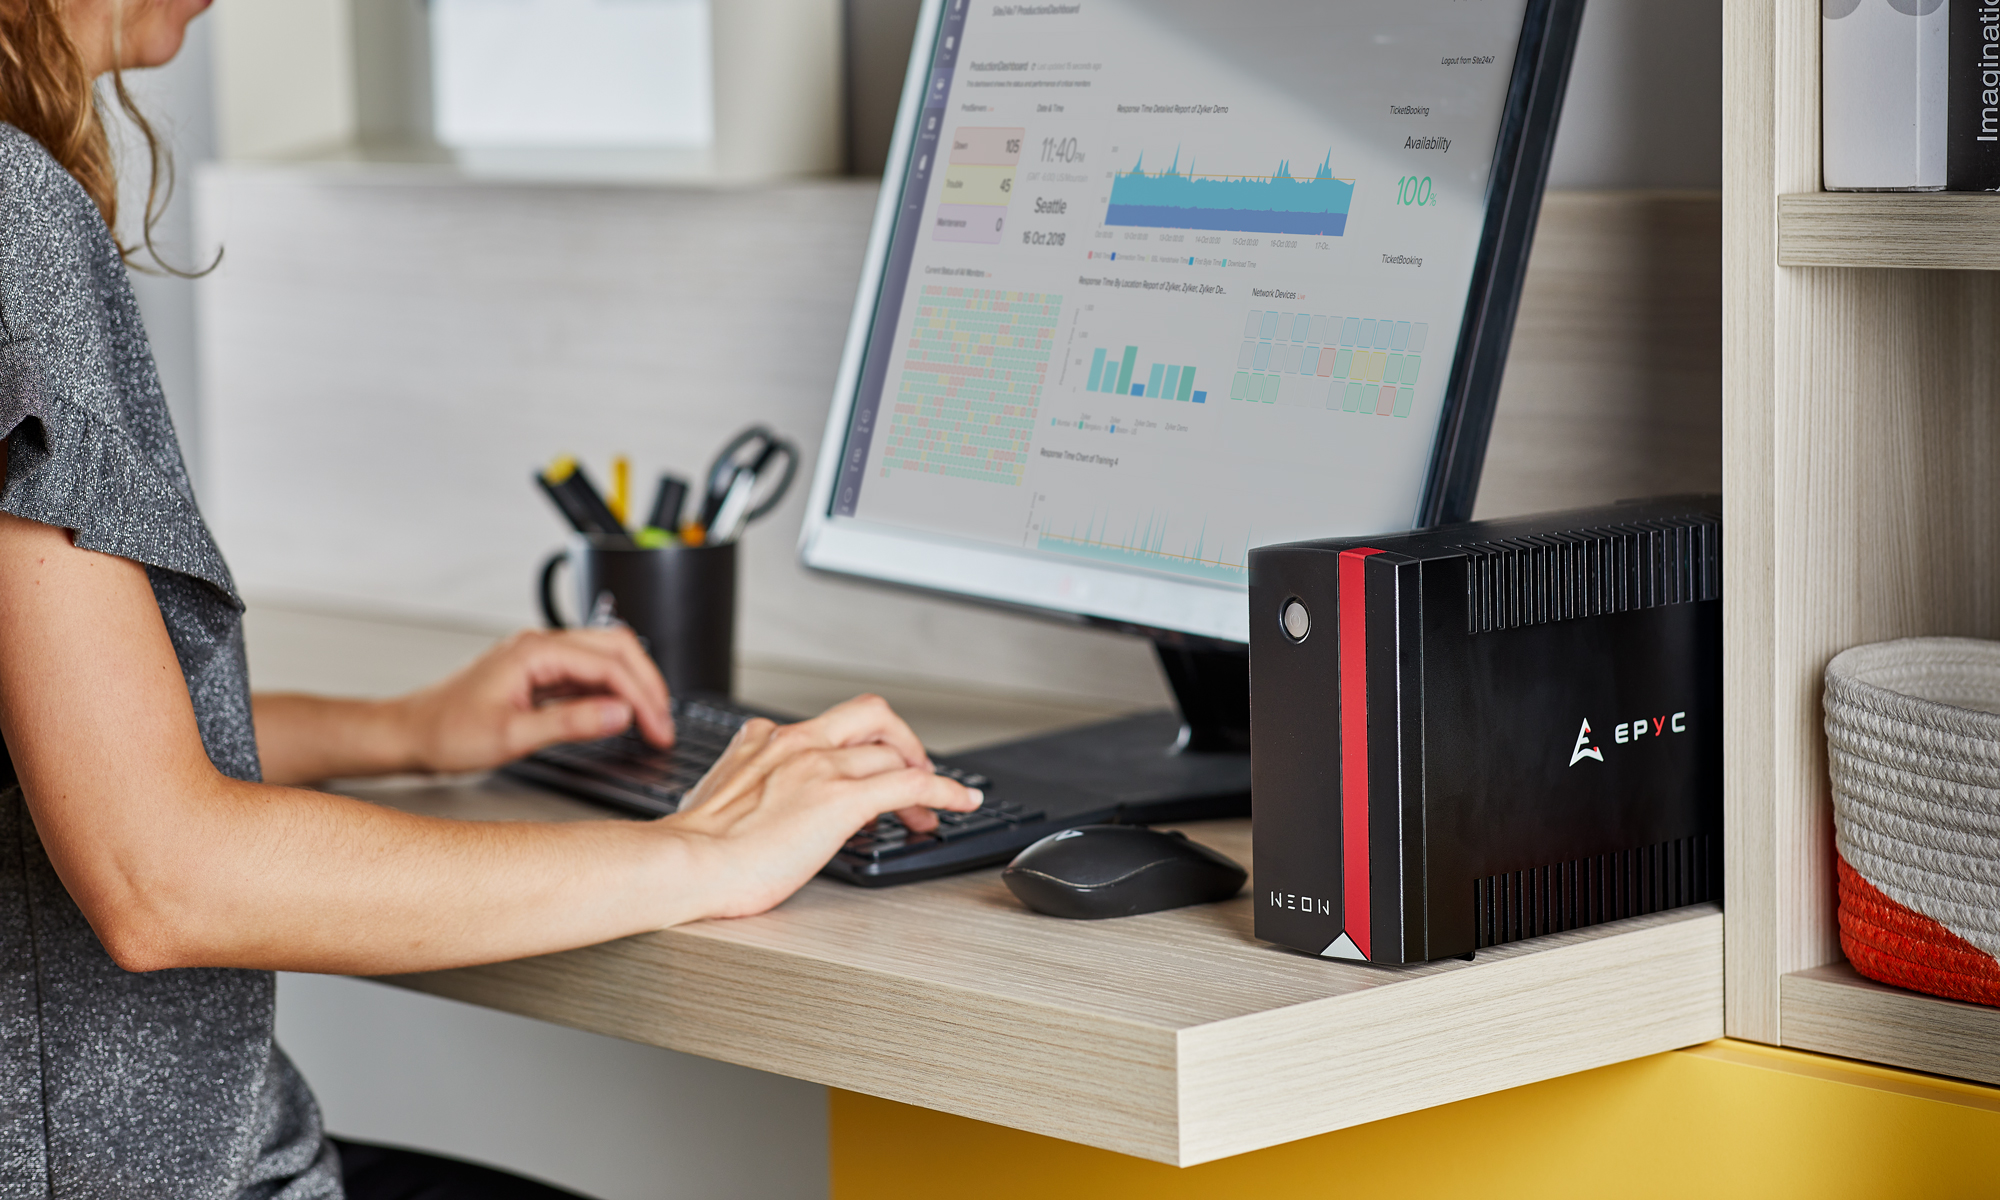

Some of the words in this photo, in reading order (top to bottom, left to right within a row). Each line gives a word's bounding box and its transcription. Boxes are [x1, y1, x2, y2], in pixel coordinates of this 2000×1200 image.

[1441, 56, 1460, 66] Logout
[1460, 56, 1471, 65] from
[1472, 55, 1495, 65] Site24x7
[1117, 104, 1140, 114] Response
[1141, 104, 1152, 113] Time
[1153, 104, 1174, 113] Detailed
[1174, 104, 1191, 114] Report
[1191, 104, 1197, 113] of
[1197, 104, 1213, 115] Zylker
[1213, 104, 1229, 114] Demo
[1389, 105, 1430, 117] TicketBooking
[1005, 139, 1020, 154] 105
[1404, 135, 1452, 153] Availability
[999, 178, 1012, 193] 45
[1034, 196, 1067, 214] Seattle
[995, 217, 1003, 232] 0
[1022, 231, 1032, 245] 16
[1032, 231, 1046, 245] Oct
[1046, 232, 1066, 246] 2018
[1381, 254, 1423, 267] TicketBooking
[1078, 276, 1101, 287] Response
[1102, 277, 1114, 287] Time
[1121, 279, 1142, 289] Location
[1142, 280, 1159, 291] Report
[1199, 283, 1215, 295] Zylker
[1251, 287, 1274, 299] Network
[1274, 289, 1297, 300] Devices
[1614, 711, 1686, 744] EPYC
[1270, 890, 1330, 916] NEON
